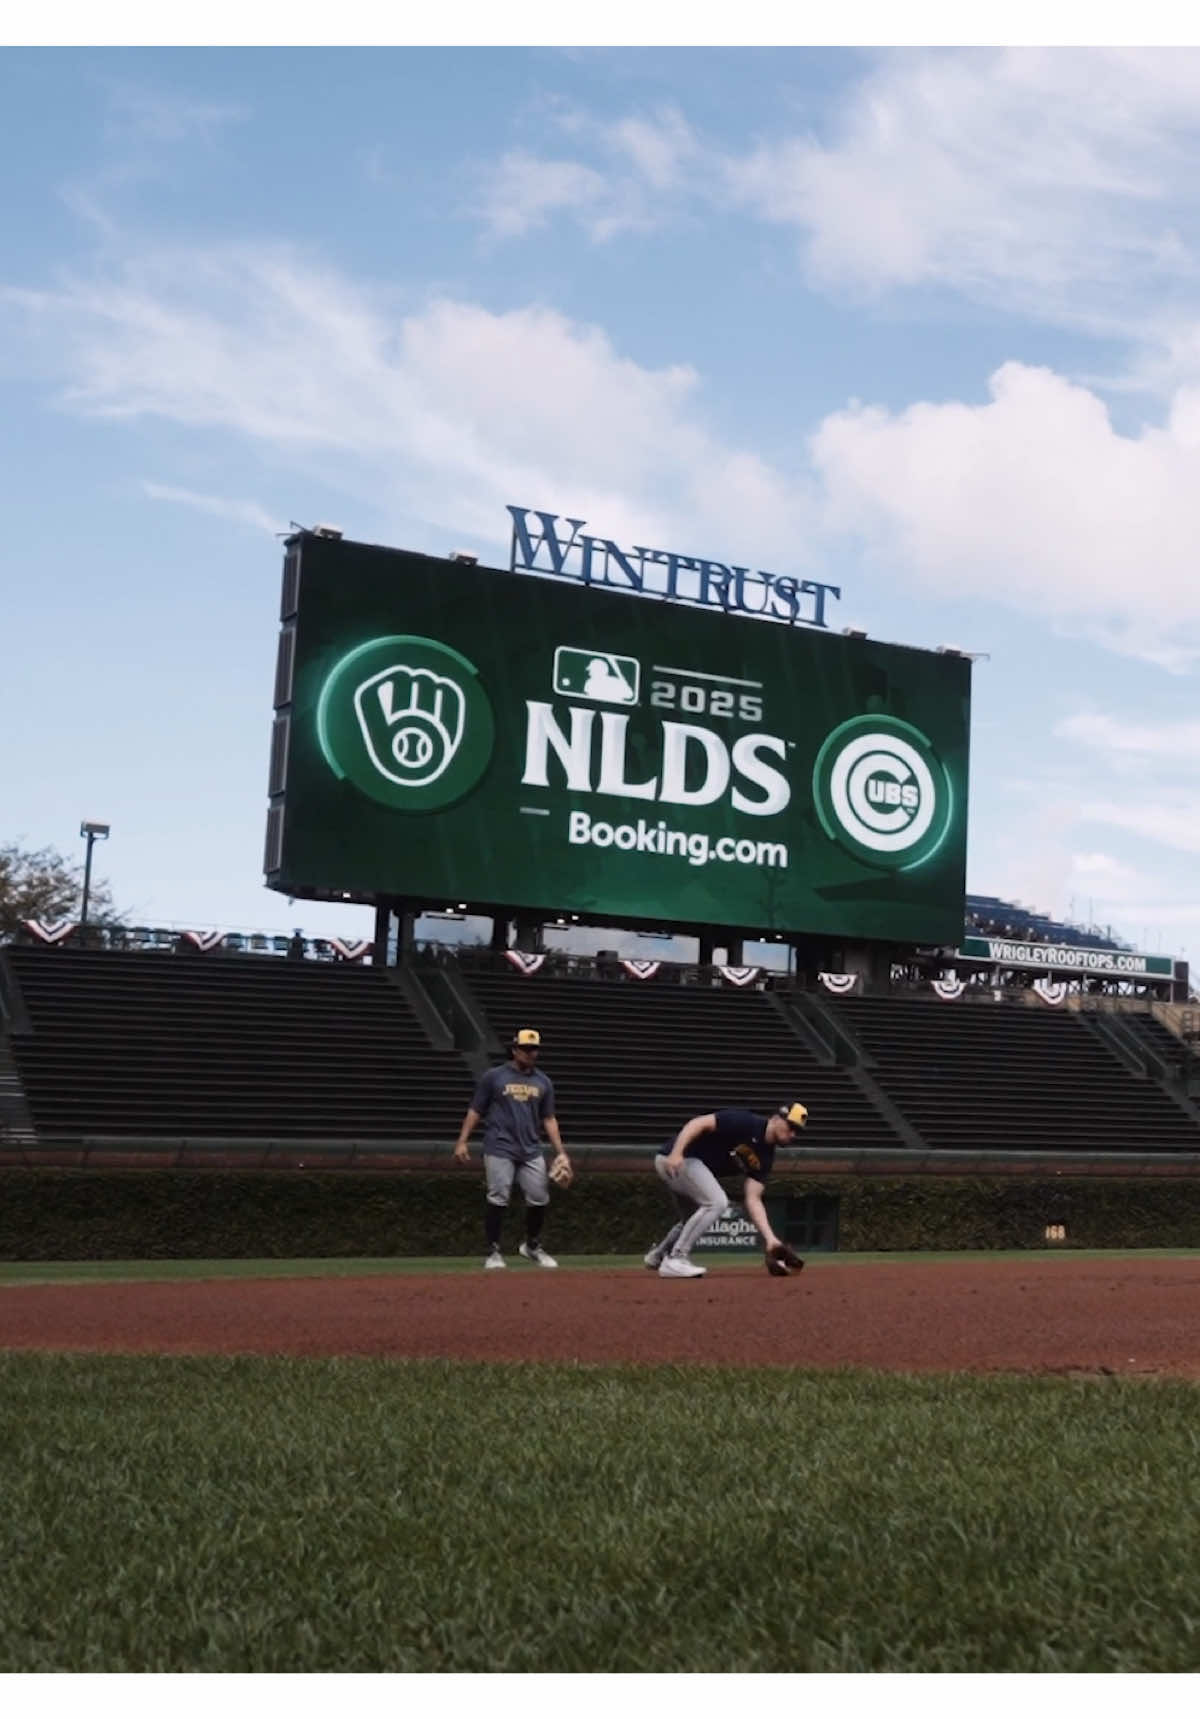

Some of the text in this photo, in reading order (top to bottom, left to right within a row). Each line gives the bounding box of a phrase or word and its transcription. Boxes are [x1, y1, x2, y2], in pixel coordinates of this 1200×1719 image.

[506, 505, 841, 628] WINTRUST
[650, 681, 763, 722] 2025
[521, 700, 791, 816] NLDS
[569, 811, 788, 868] Booking.com
[988, 942, 1147, 972] WRIGLEYROOFTOPS.COM
